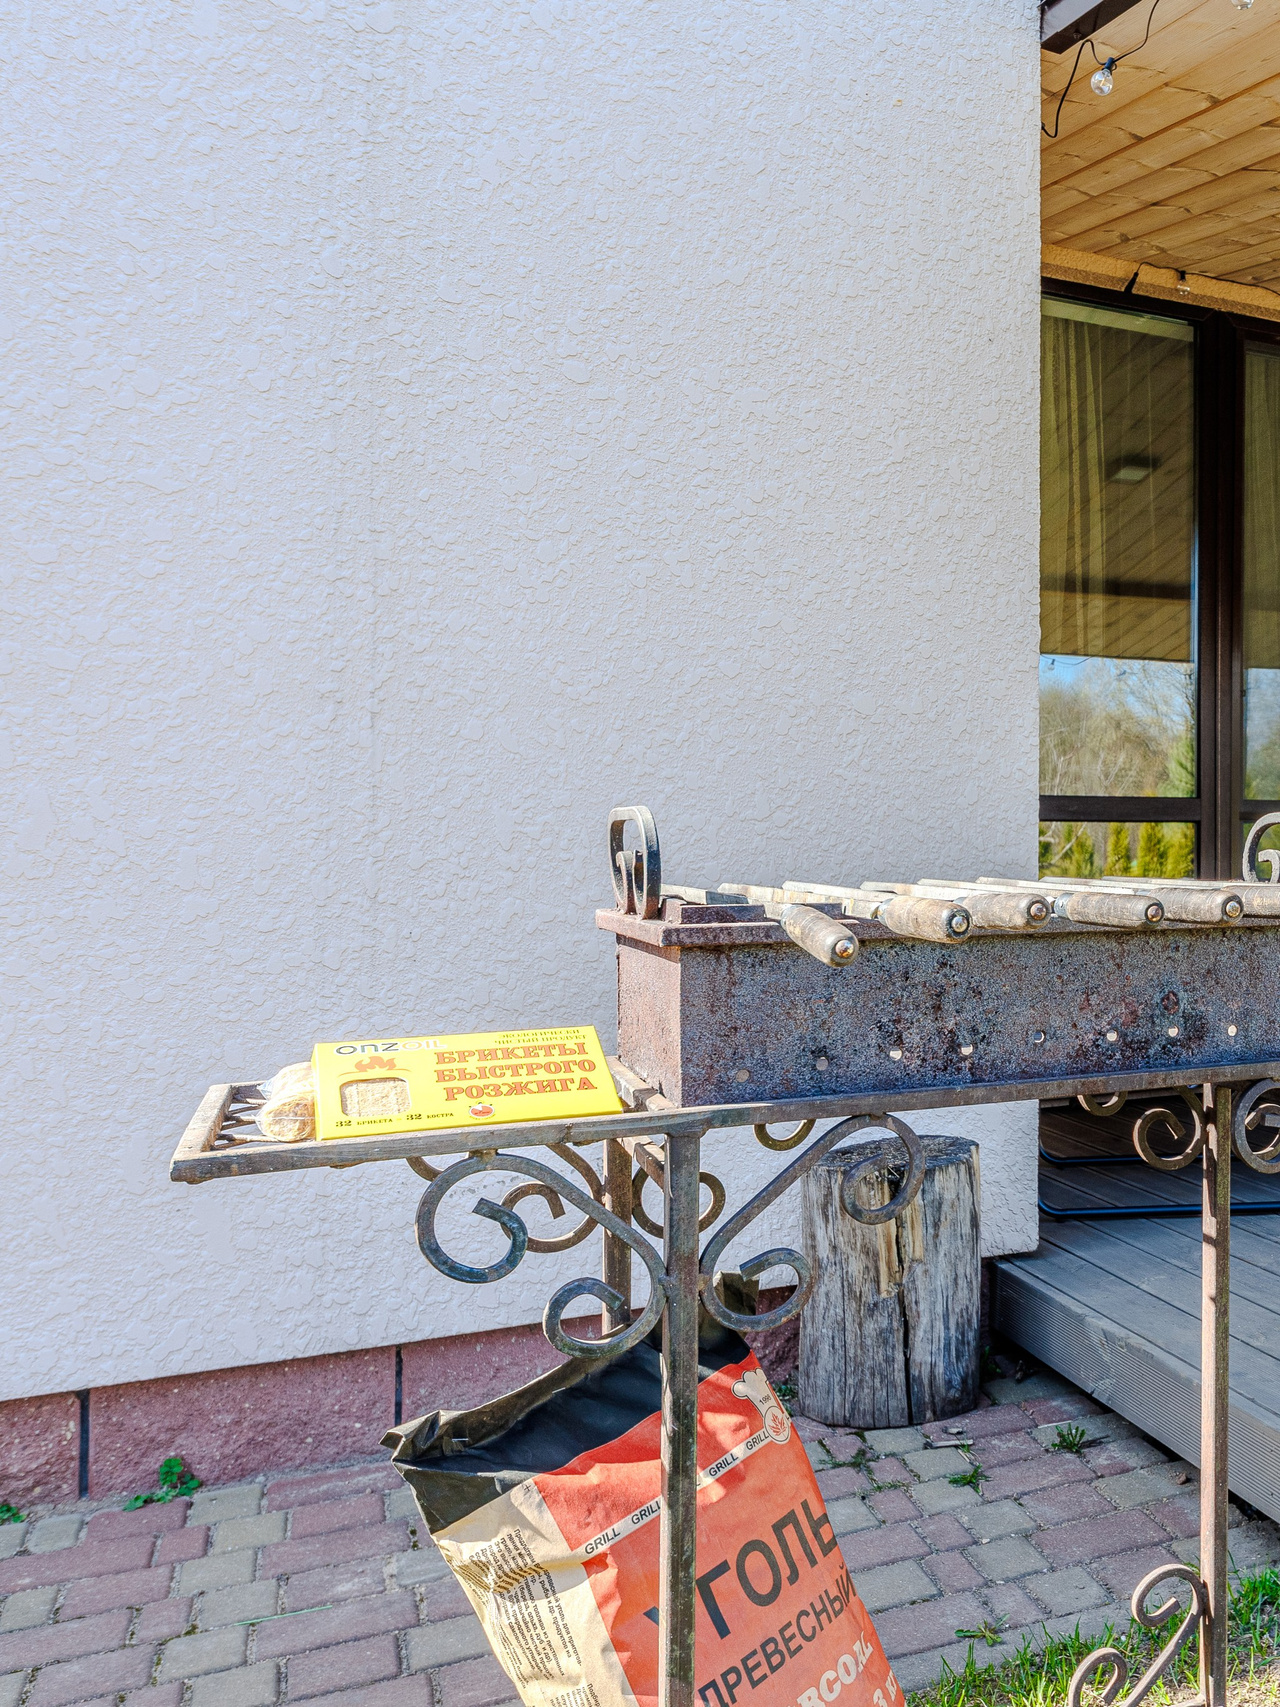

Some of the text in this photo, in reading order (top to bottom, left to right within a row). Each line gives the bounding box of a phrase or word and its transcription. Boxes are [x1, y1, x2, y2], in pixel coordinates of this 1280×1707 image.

[434, 1042, 589, 1065] БРИКЕТЫ
[434, 1059, 597, 1083] БЫСТРОГО
[406, 1113, 422, 1121] 32
[443, 1077, 598, 1101] РОЗЖИГА
[585, 1527, 621, 1555] GRILL
[708, 1453, 739, 1477] GRILL
[745, 1430, 769, 1451] GRILL
[486, 1544, 500, 1564] пород
[534, 1631, 545, 1645] дуб
[505, 1532, 520, 1552] ления
[538, 1579, 551, 1599] рыбы
[552, 1615, 568, 1649] продуктов
[513, 1528, 536, 1564] Предлагаем
[554, 1602, 566, 1622] уголь
[561, 1622, 571, 1635] для
[643, 1498, 838, 1640] ГОЛЬ
[493, 1540, 503, 1553] Это
[531, 1603, 546, 1631] топливо
[545, 1639, 565, 1676] лиственных
[511, 1609, 529, 1646] природного
[528, 1632, 542, 1656] чистый
[788, 1630, 874, 1707] RCOAL
[586, 1682, 601, 1707] Подбир
